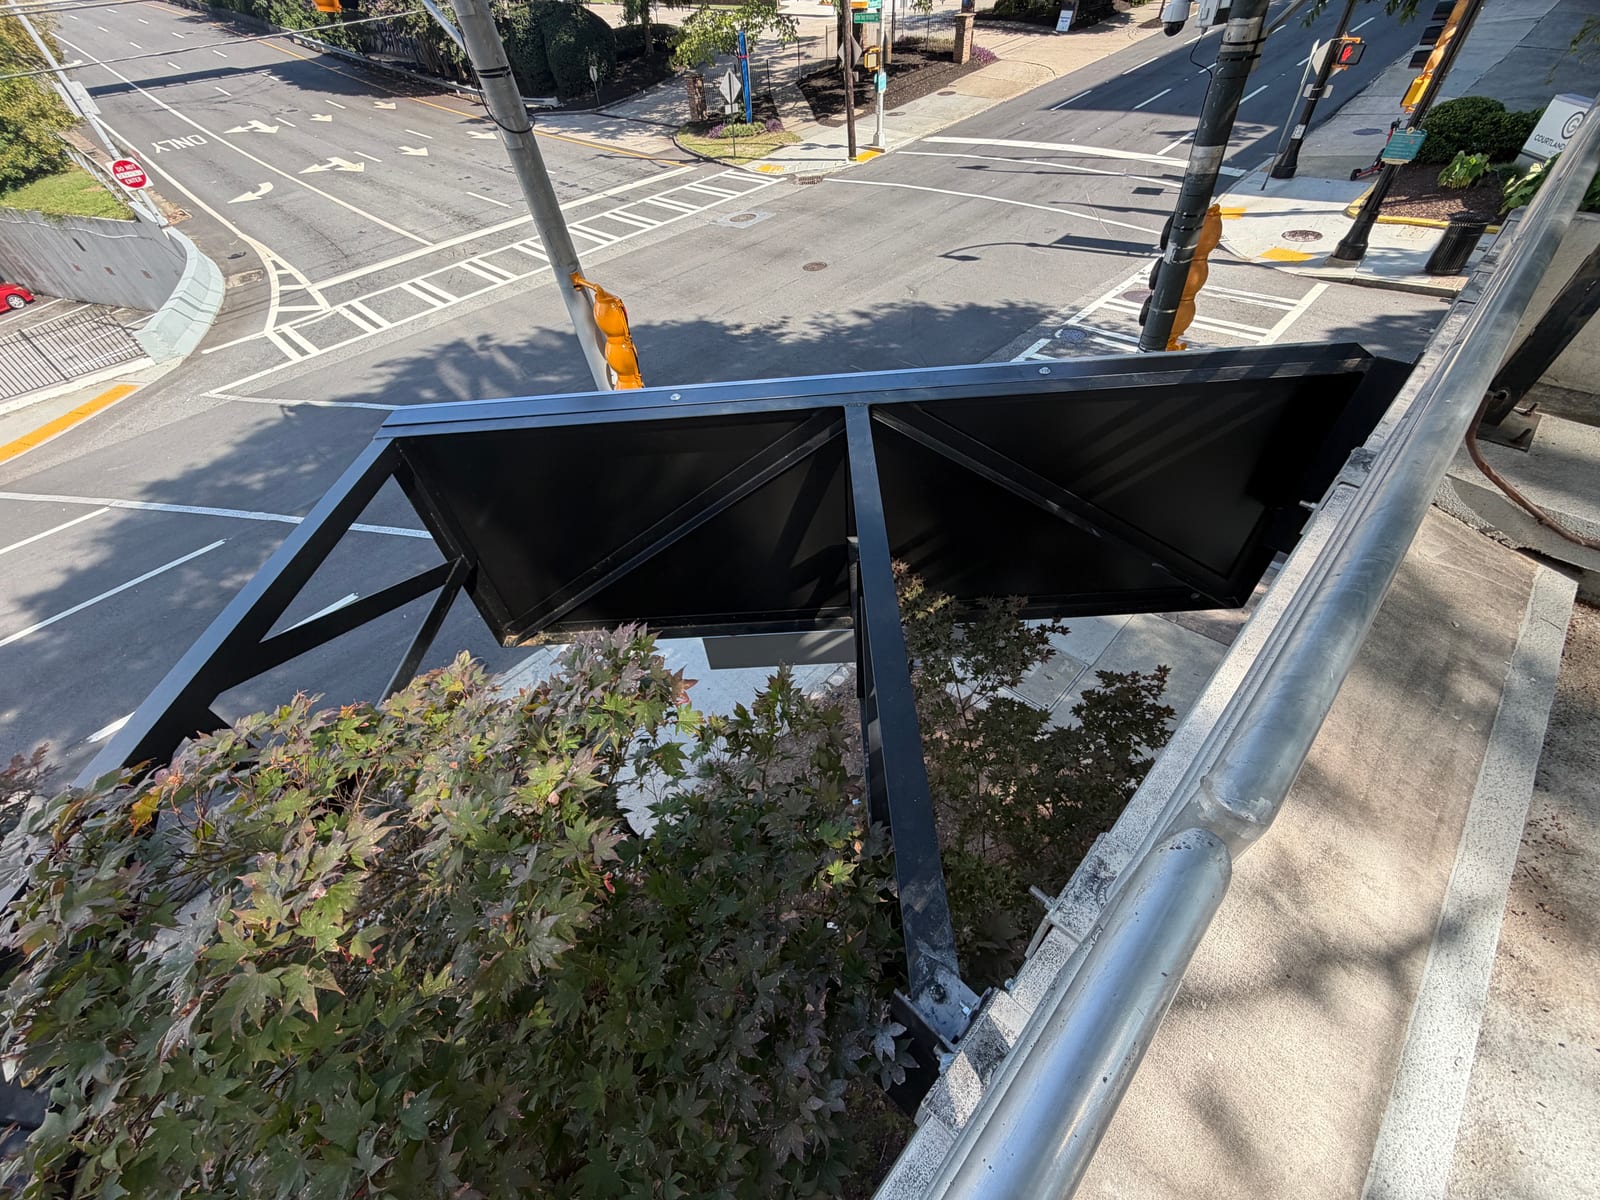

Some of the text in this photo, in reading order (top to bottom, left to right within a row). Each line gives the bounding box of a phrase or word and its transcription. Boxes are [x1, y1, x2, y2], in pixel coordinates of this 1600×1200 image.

[151, 134, 208, 153] ONLY
[124, 163, 137, 171] NOT
[124, 176, 143, 184] ENTER
